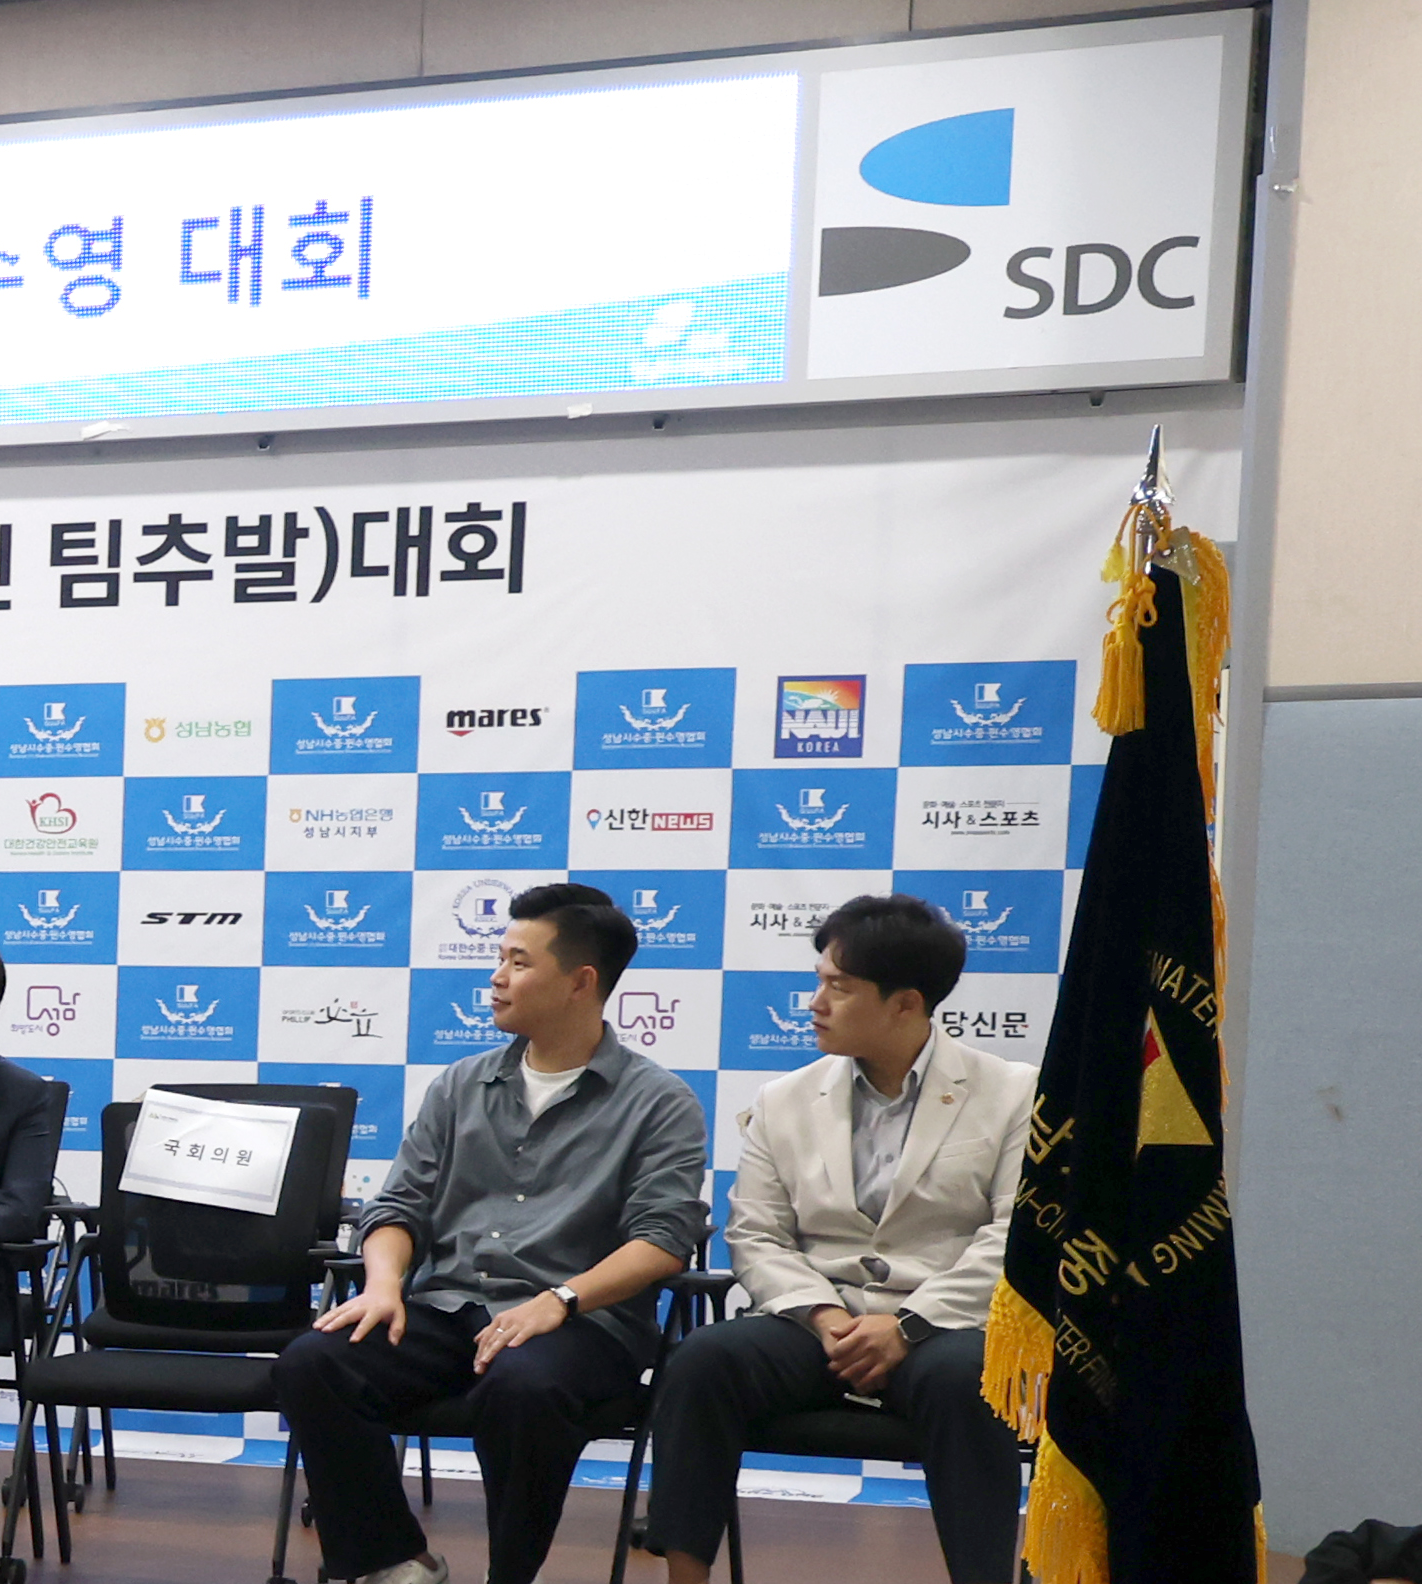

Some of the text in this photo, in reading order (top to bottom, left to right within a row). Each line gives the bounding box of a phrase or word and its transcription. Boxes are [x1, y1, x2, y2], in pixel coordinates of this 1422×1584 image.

[179, 194, 376, 309] 대회
[1001, 234, 1200, 321] SDC
[446, 708, 543, 729] mares
[175, 720, 253, 738] 성남농협
[797, 741, 840, 753] KOREA
[922, 810, 1040, 829] 시사 & 스포츠
[750, 913, 802, 931] 시사 &
[942, 1011, 1028, 1039] 당신문
